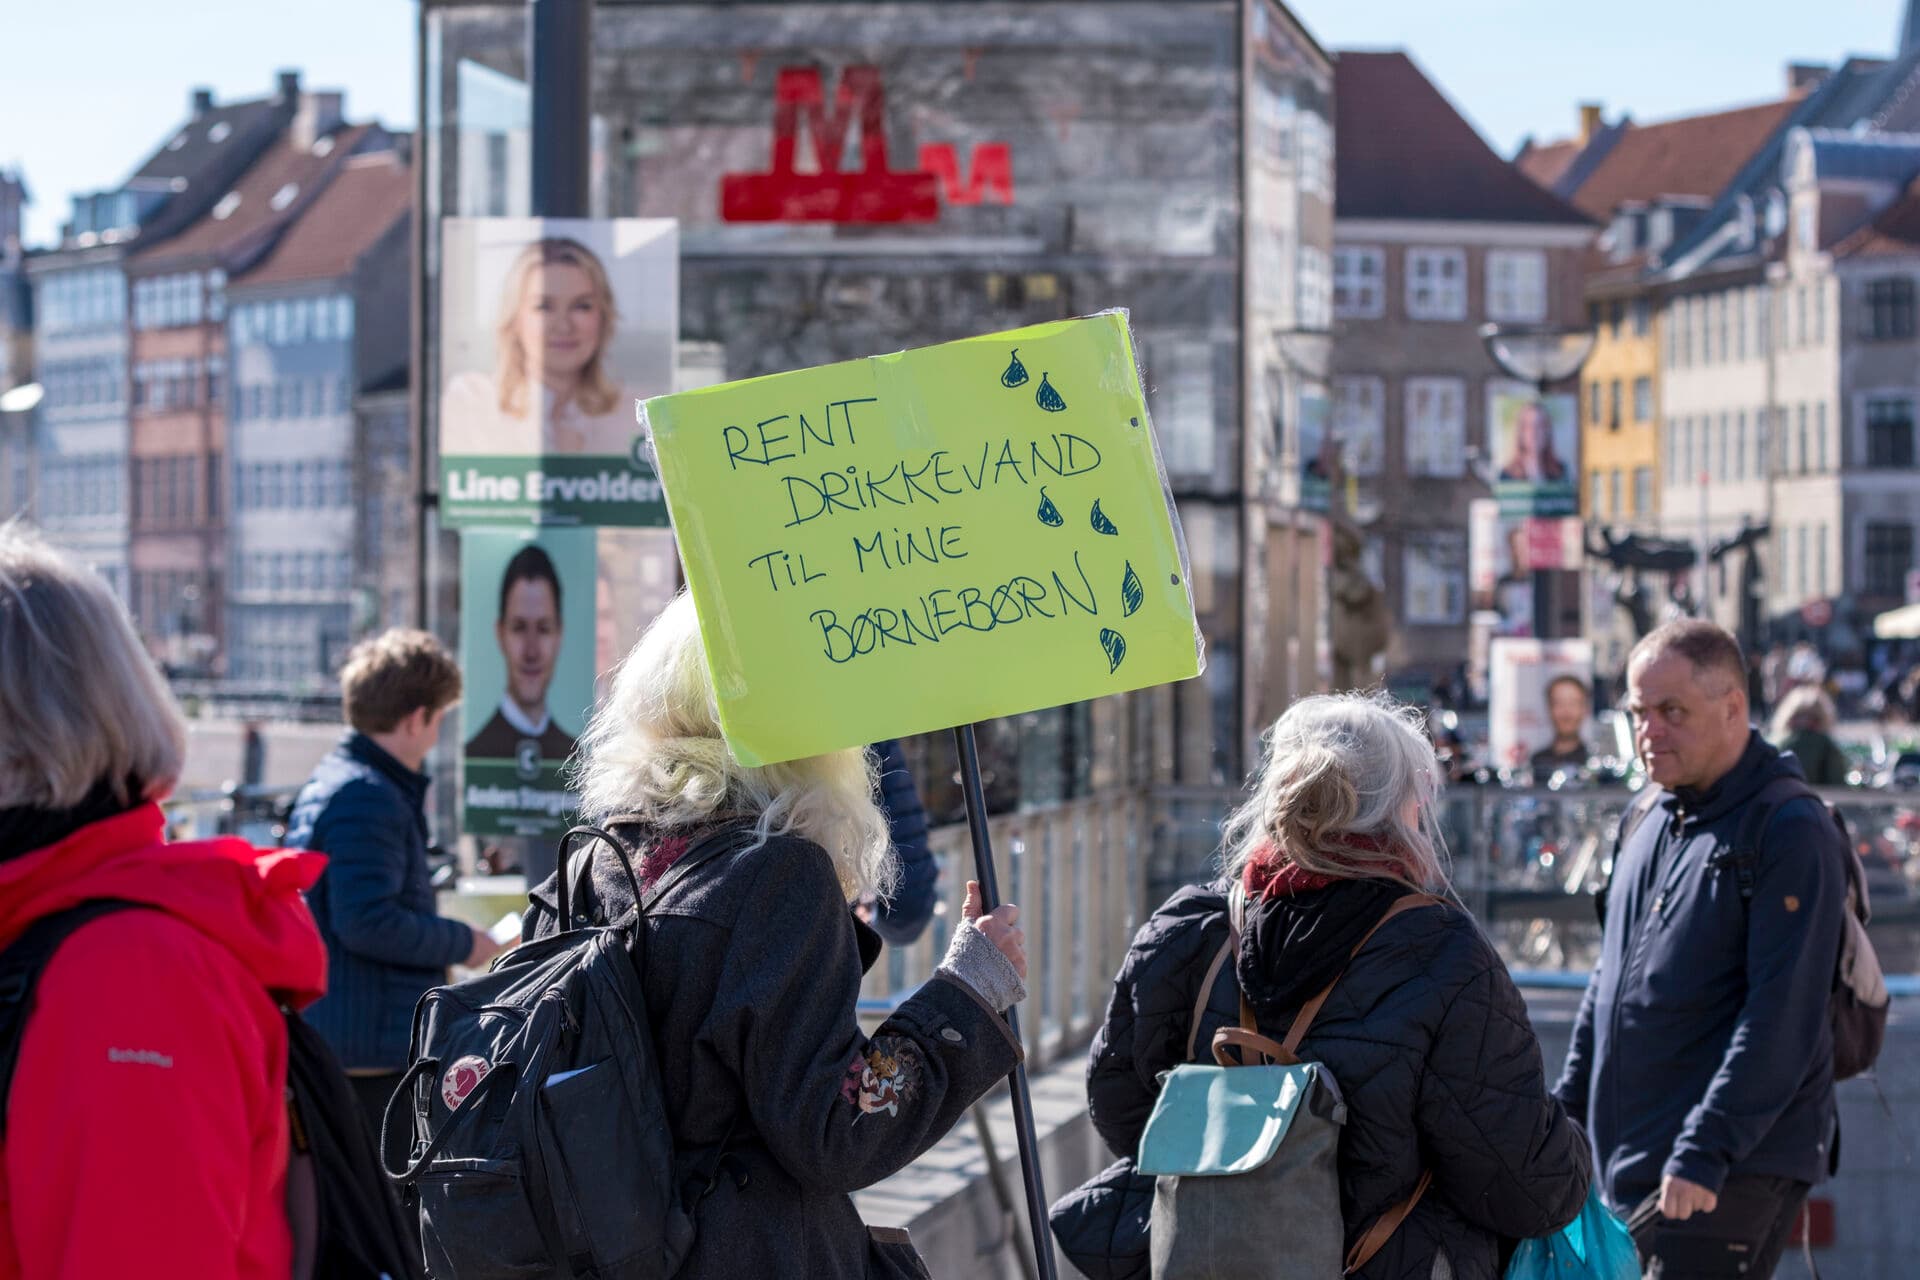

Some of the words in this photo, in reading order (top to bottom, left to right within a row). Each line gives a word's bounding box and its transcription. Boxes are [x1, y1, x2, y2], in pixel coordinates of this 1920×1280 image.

[723, 397, 878, 471] RENT
[447, 468, 521, 501] Line
[810, 551, 1098, 664] BØRNEBØRN
